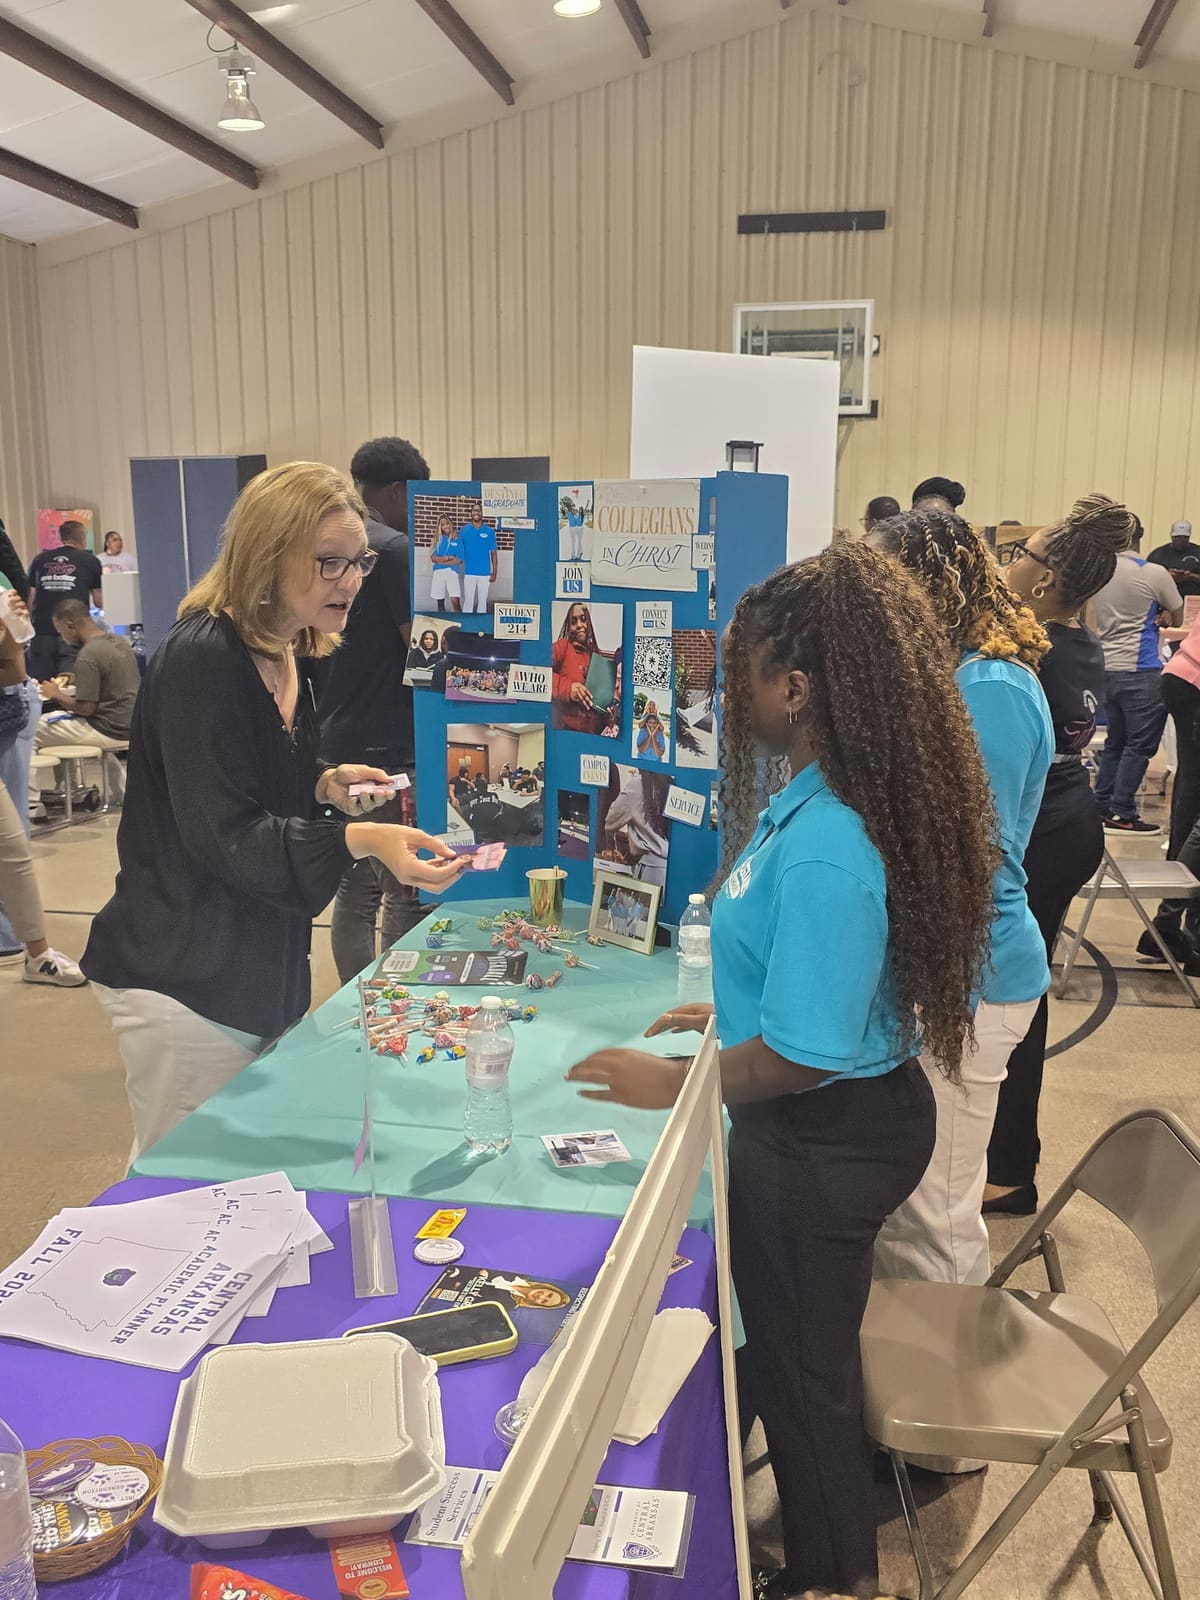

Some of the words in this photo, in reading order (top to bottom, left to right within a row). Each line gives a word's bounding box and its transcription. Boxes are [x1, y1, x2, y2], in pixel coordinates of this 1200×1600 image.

[598, 506, 695, 535] COLLEGIANS
[602, 546, 615, 559] IN
[614, 540, 690, 572] CHRIST
[562, 567, 583, 580] JOIN
[566, 580, 580, 592] US
[498, 607, 537, 617] STUDENT
[642, 609, 667, 619] CONNECT
[655, 619, 666, 629] US
[507, 623, 528, 634] 214
[513, 681, 528, 691] WE
[532, 683, 549, 693] ARE
[519, 671, 545, 683] WHO
[583, 759, 608, 771] CAMPUS
[670, 797, 701, 817] SERVICE
[30, 1228, 83, 1265] FALL
[163, 1245, 217, 1295] ACADEMIC
[0, 1271, 36, 1304] 202
[150, 1261, 233, 1336] ARKANSAS
[179, 1271, 253, 1335] CENTRAL
[110, 1296, 169, 1344] PLANNER
[425, 1504, 448, 1537] Student
[441, 1472, 461, 1504] Success
[446, 1490, 469, 1523] Services
[636, 1500, 651, 1538] CENTRAL
[55, 1502, 73, 1541] CROWN
[645, 1497, 660, 1542] ARKANSAS
[344, 1572, 356, 1580] TO
[357, 1563, 393, 1577] WELCOME
